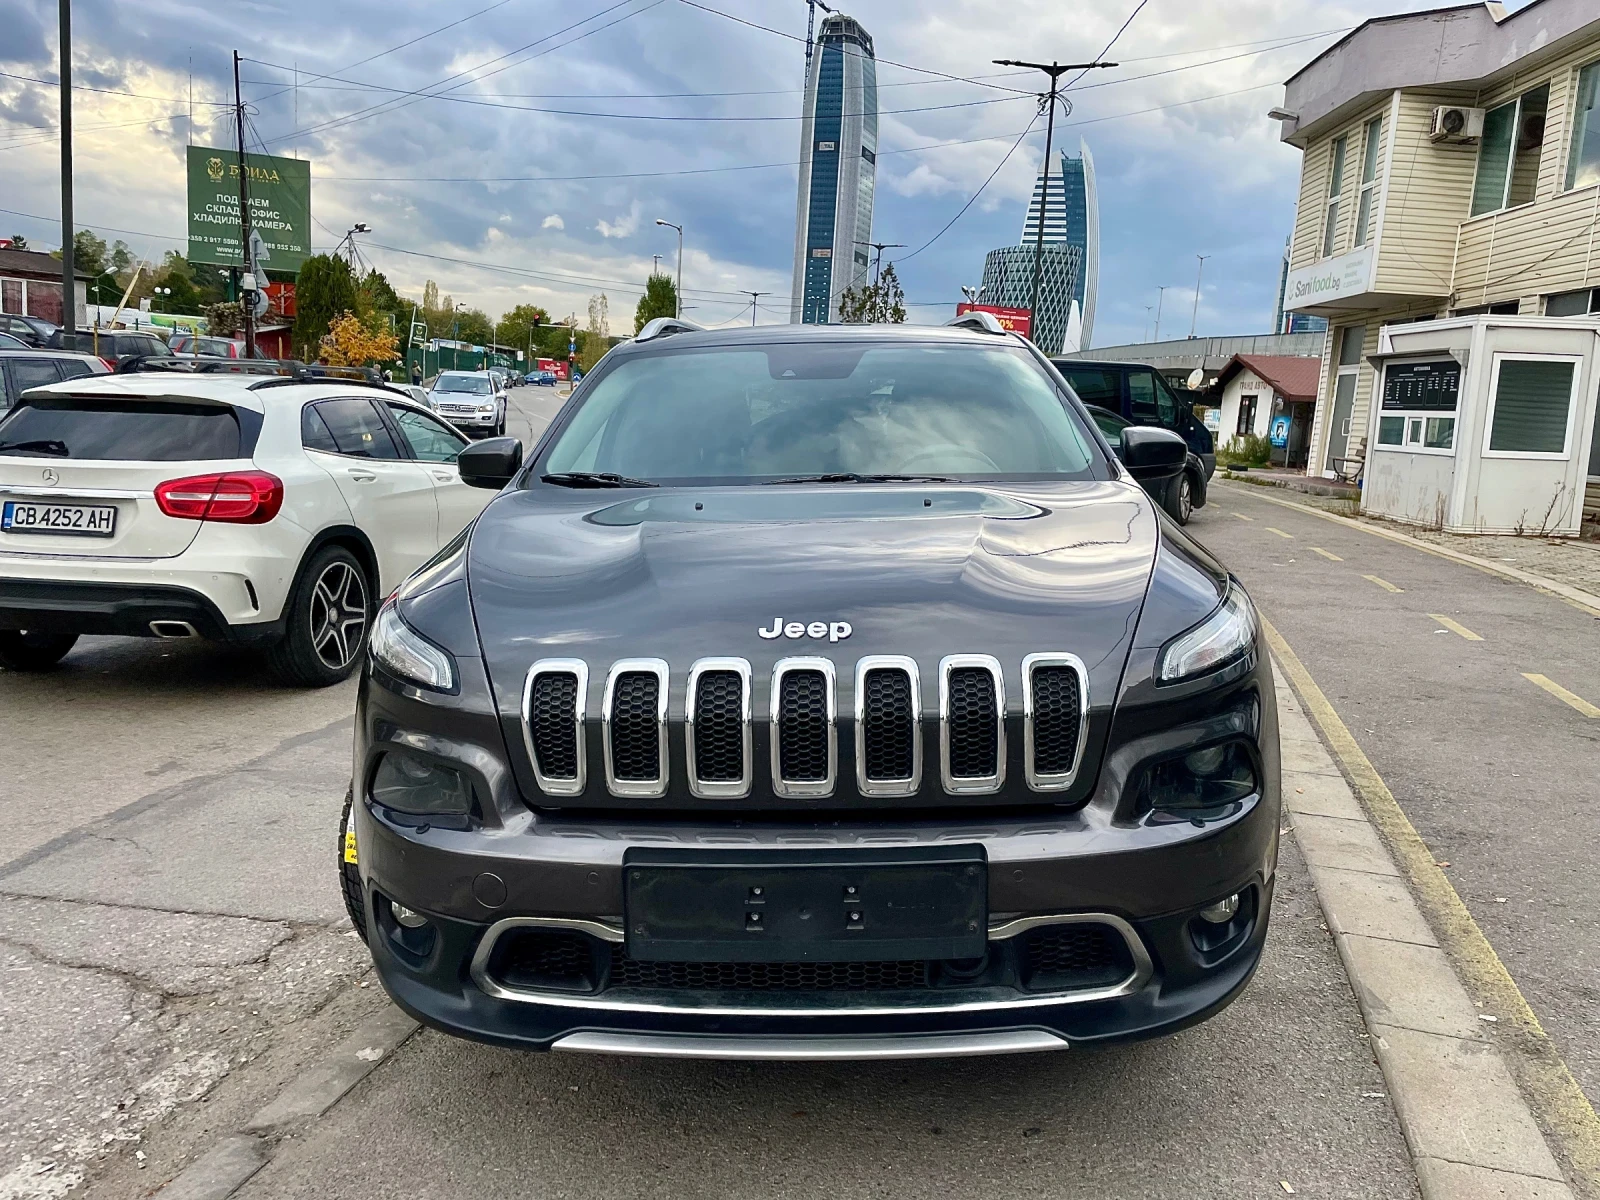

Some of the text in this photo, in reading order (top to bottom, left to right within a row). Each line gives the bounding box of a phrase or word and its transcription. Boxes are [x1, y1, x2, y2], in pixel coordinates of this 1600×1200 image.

[216, 194, 270, 208] ПОД АЕМ
[193, 212, 293, 232] ХЛАДИЛН КАМЕРА
[251, 208, 280, 219] ОФИС
[1295, 272, 1341, 298] Sanifood.bg
[14, 506, 111, 529] CB 4252 AH
[757, 616, 853, 643] Jeep
